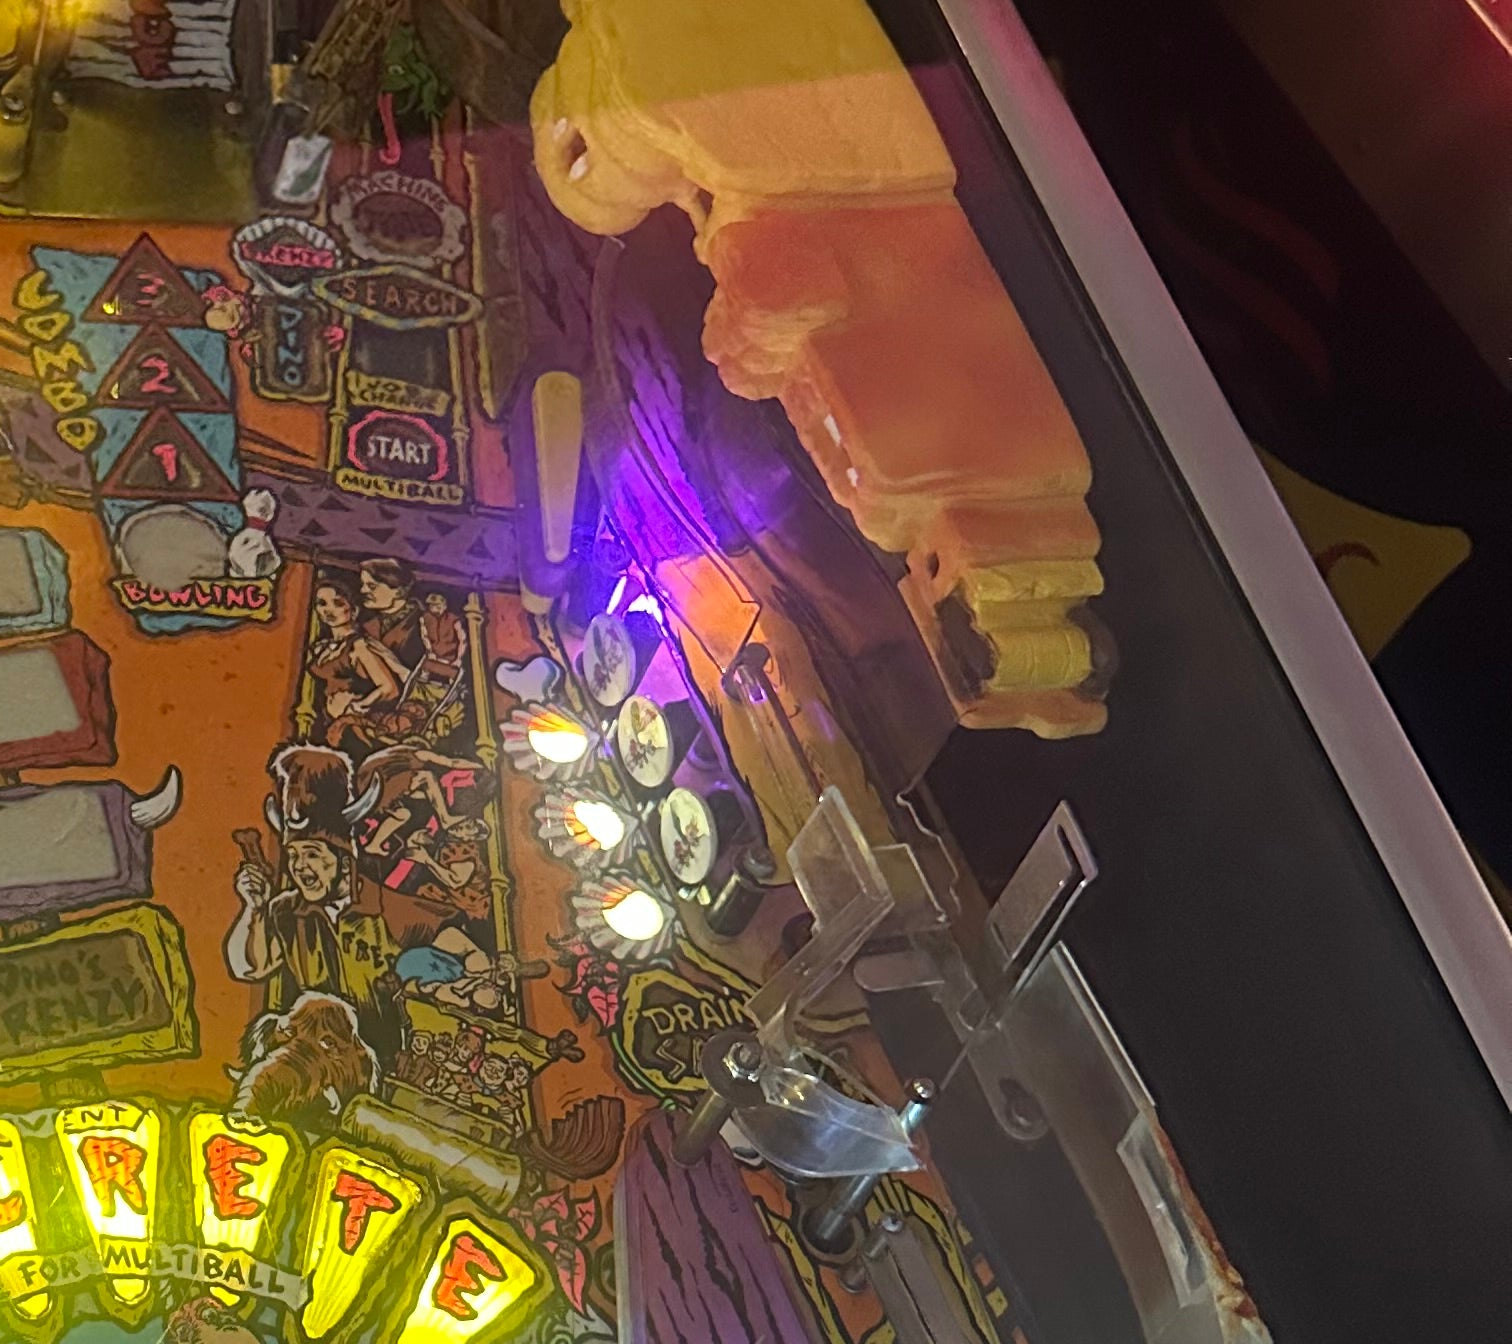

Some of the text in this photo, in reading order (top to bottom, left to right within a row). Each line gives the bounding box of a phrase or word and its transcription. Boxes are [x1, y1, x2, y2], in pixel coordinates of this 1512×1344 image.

[133, 272, 170, 309] 3
[339, 276, 458, 317] SEARCH
[16, 268, 100, 452] COMBO
[277, 304, 308, 388] DINO
[139, 357, 178, 395] 2
[152, 442, 179, 482] 1
[365, 434, 432, 466] START
[340, 471, 460, 502] MULTIBALL
[121, 577, 269, 612] BOWLING
[641, 997, 746, 1036] DRAIN
[19, 1255, 82, 1288] FOR
[101, 1245, 286, 1294] MULTIBALL
